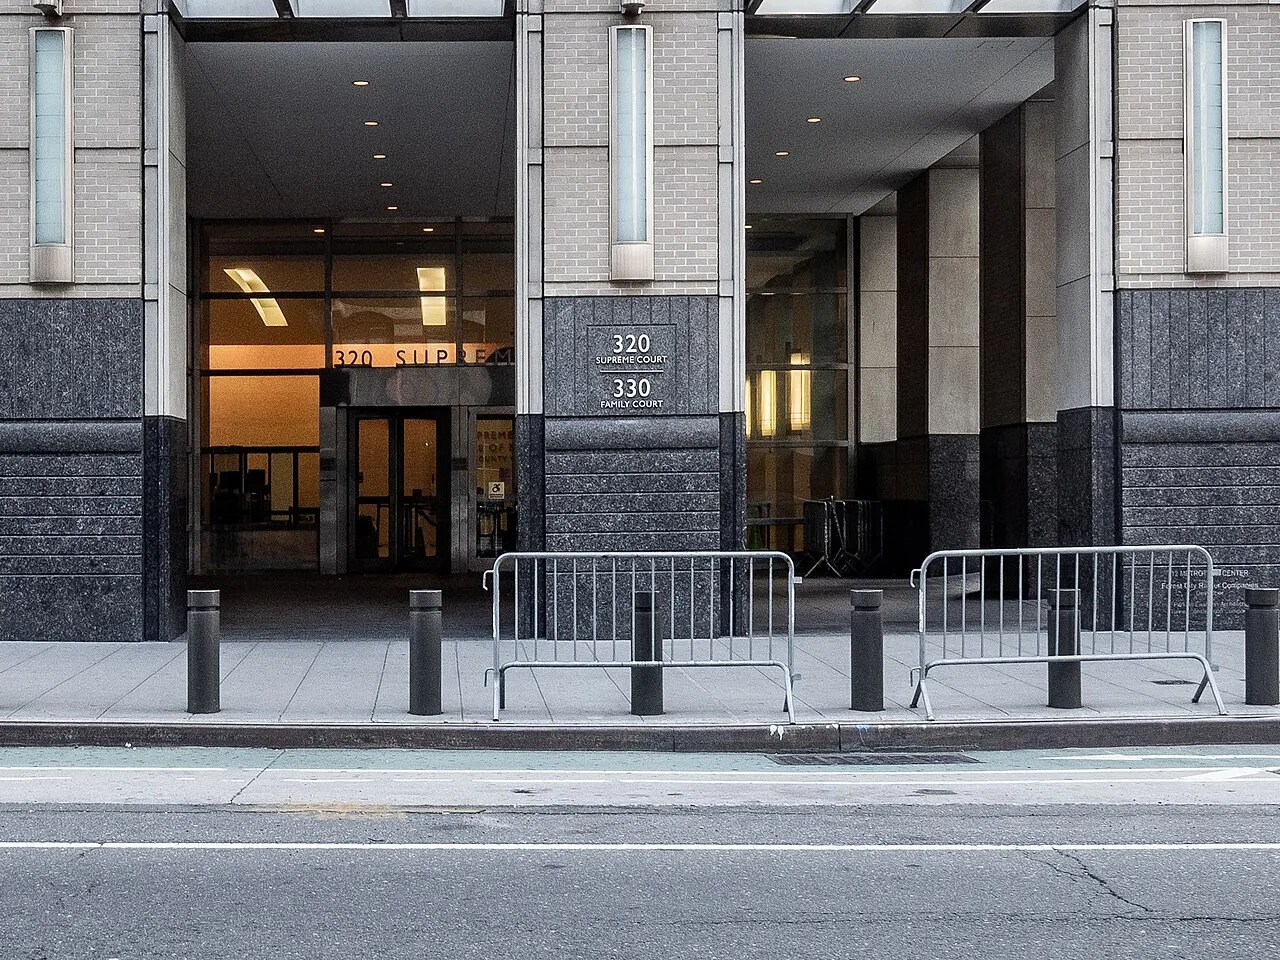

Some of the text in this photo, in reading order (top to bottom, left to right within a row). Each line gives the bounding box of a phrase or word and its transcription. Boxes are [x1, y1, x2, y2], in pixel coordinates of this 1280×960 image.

[613, 333, 650, 353] 320
[335, 350, 373, 366] 320
[596, 355, 668, 364] SUPREME COURT
[613, 378, 651, 398] 330
[600, 400, 664, 408] FAMILY COURT
[1184, 582, 1197, 590] Cty
